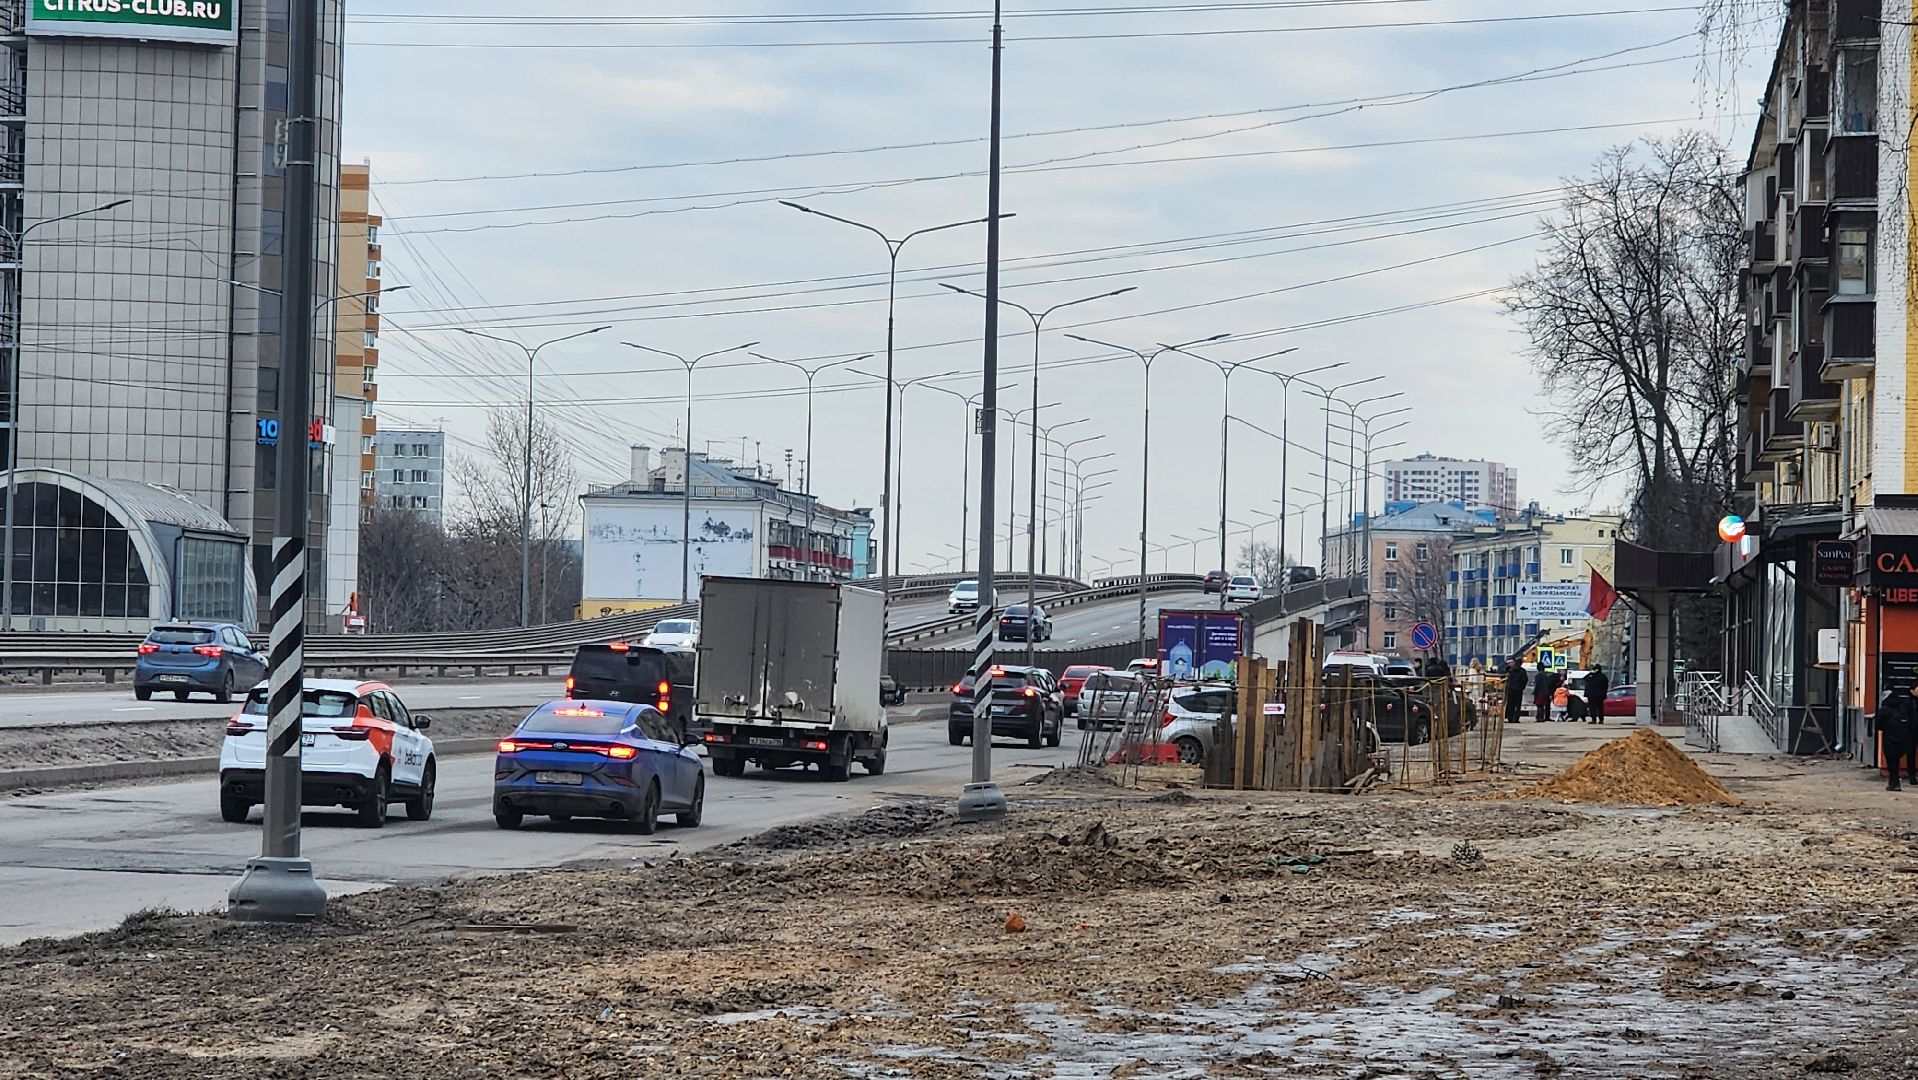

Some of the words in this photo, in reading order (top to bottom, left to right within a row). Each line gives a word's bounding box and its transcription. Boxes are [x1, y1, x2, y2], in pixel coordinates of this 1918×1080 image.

[43, 0, 221, 19] CITRUS-CLUB.RU
[258, 419, 278, 438] 10
[1877, 553, 1918, 573] СА
